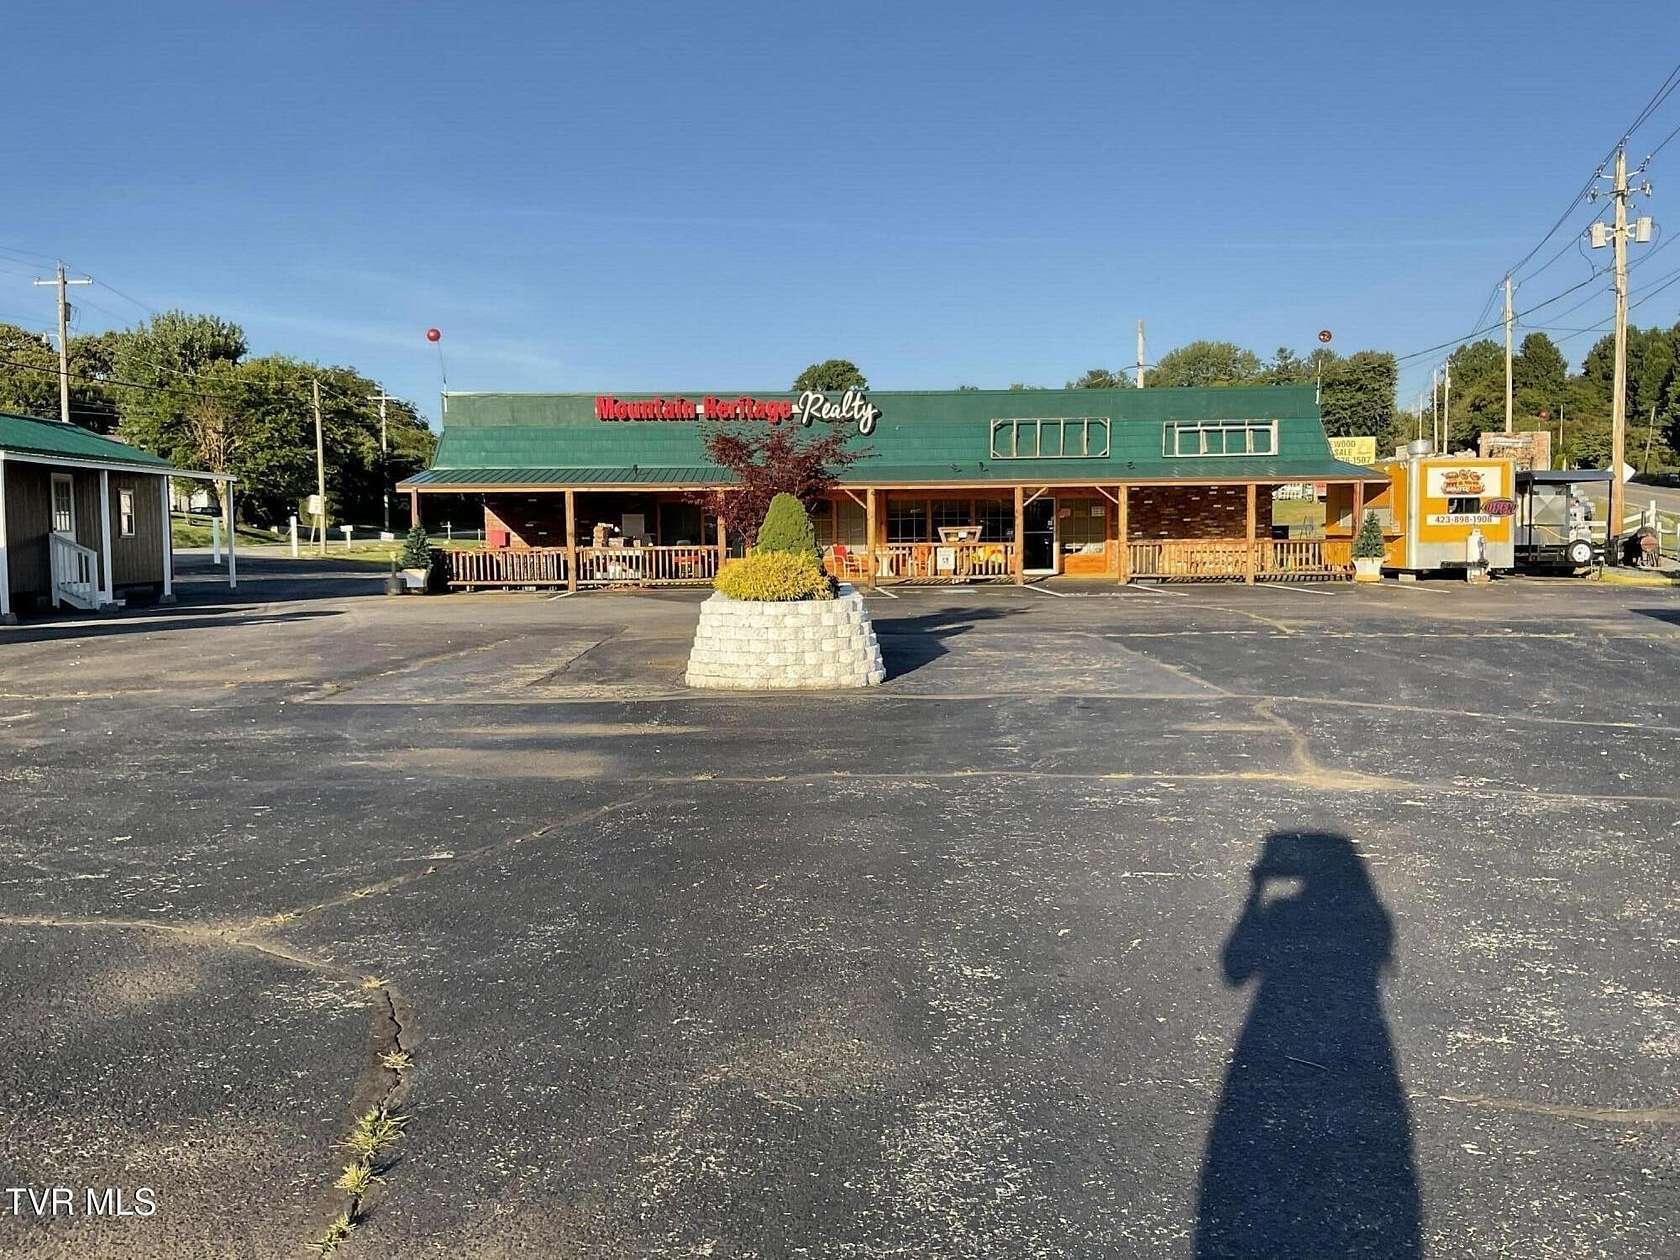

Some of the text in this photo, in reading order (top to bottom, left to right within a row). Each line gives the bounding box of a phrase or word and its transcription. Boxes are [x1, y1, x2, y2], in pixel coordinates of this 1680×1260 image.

[596, 390, 880, 434] Mountain Heritage Realty
[1334, 448, 1353, 456] SALE
